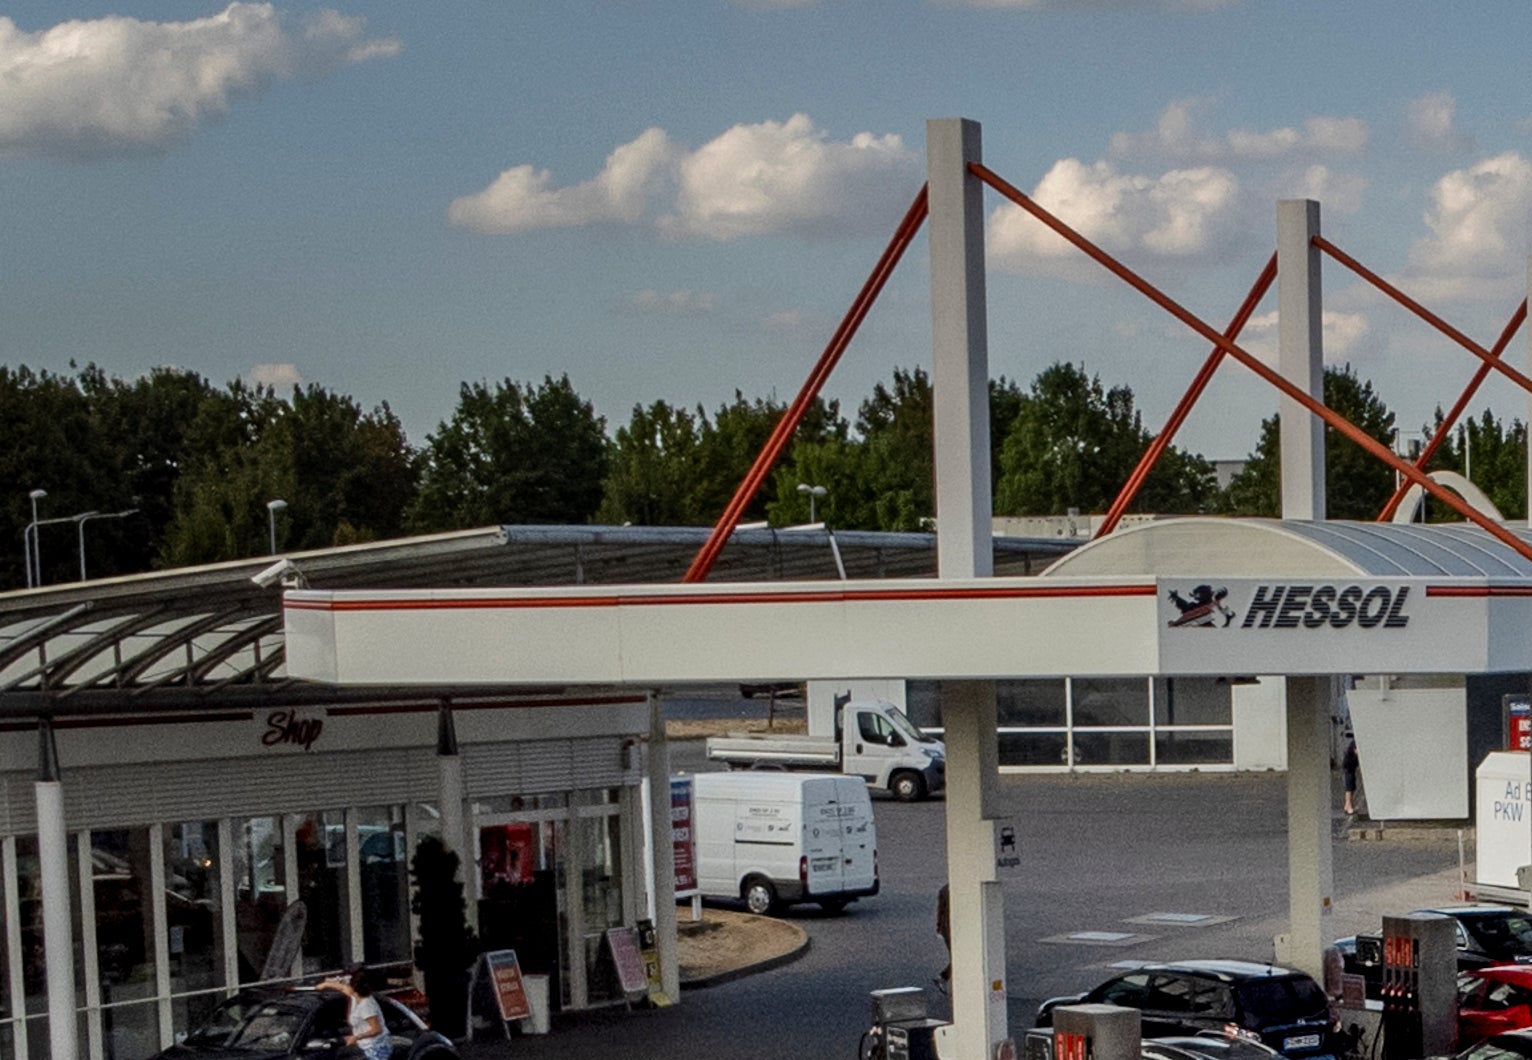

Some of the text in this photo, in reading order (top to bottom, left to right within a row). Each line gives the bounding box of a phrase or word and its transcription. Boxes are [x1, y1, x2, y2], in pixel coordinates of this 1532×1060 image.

[1241, 586, 1411, 629] HESSOL
[261, 709, 323, 751] Shop
[1504, 780, 1521, 801] Ad
[1494, 801, 1524, 822] PKW
